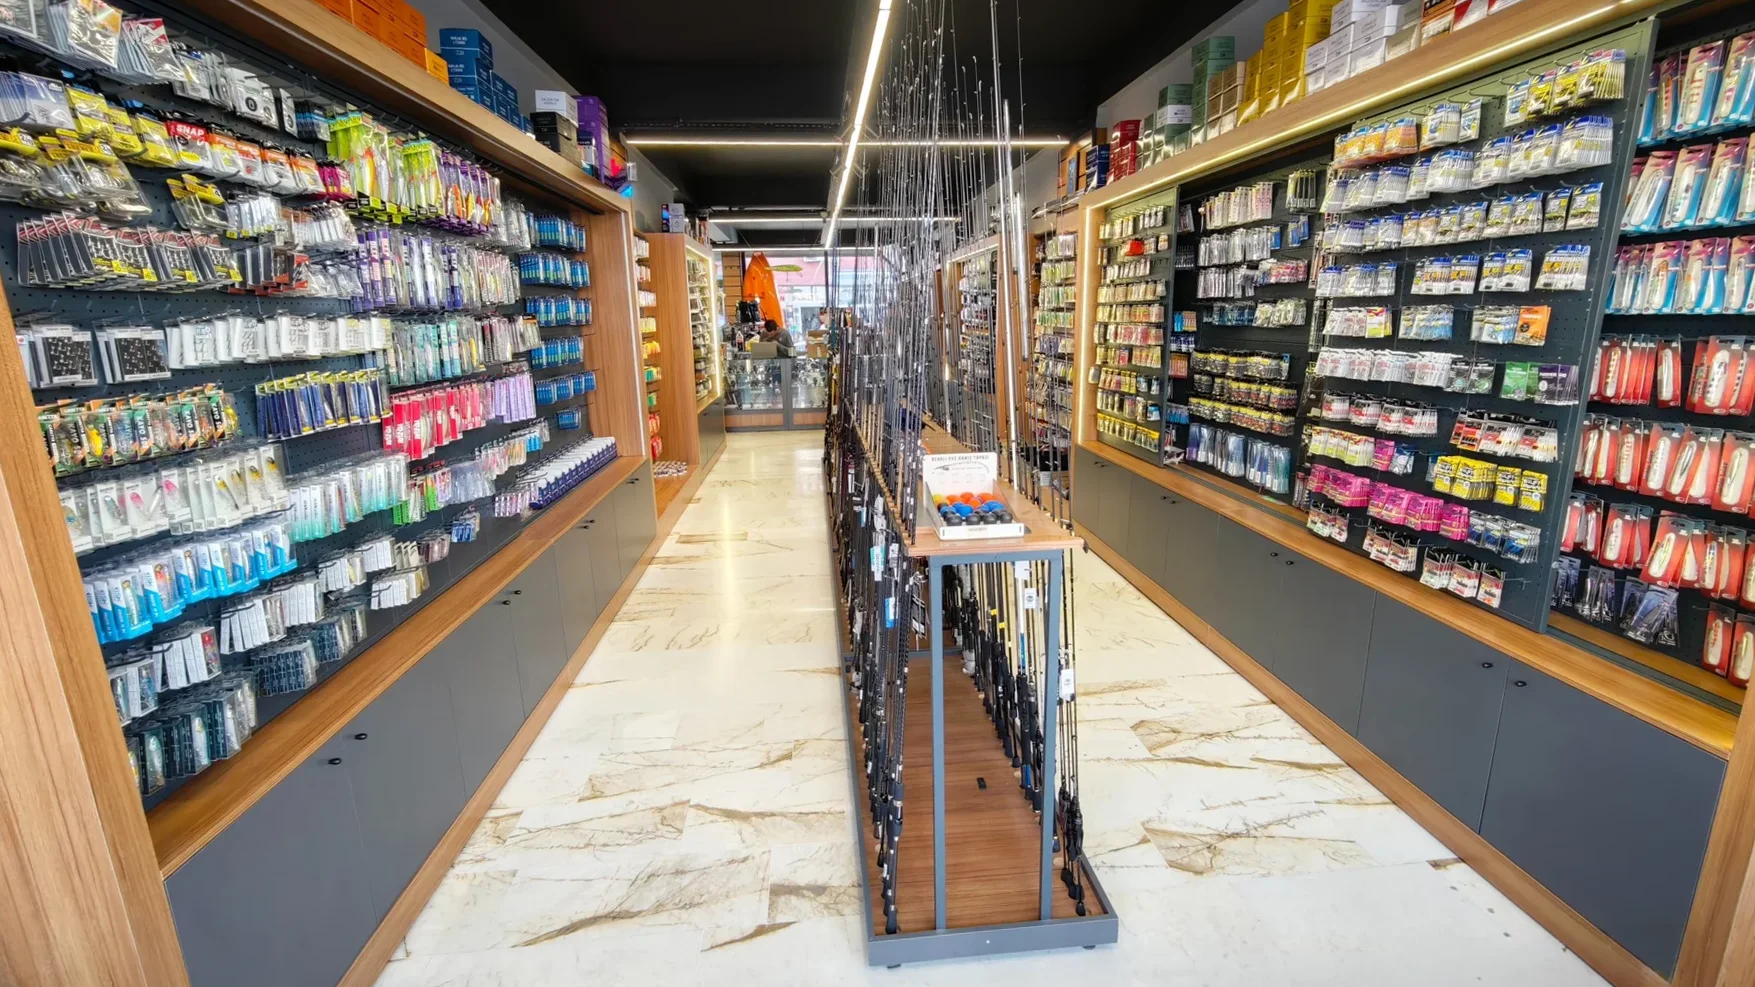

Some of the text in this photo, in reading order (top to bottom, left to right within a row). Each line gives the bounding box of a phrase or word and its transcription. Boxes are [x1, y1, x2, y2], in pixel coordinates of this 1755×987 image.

[175, 124, 205, 137] SNAP
[185, 410, 193, 428] KAYO
[212, 403, 220, 420] KAYO
[136, 415, 145, 435] KAYO
